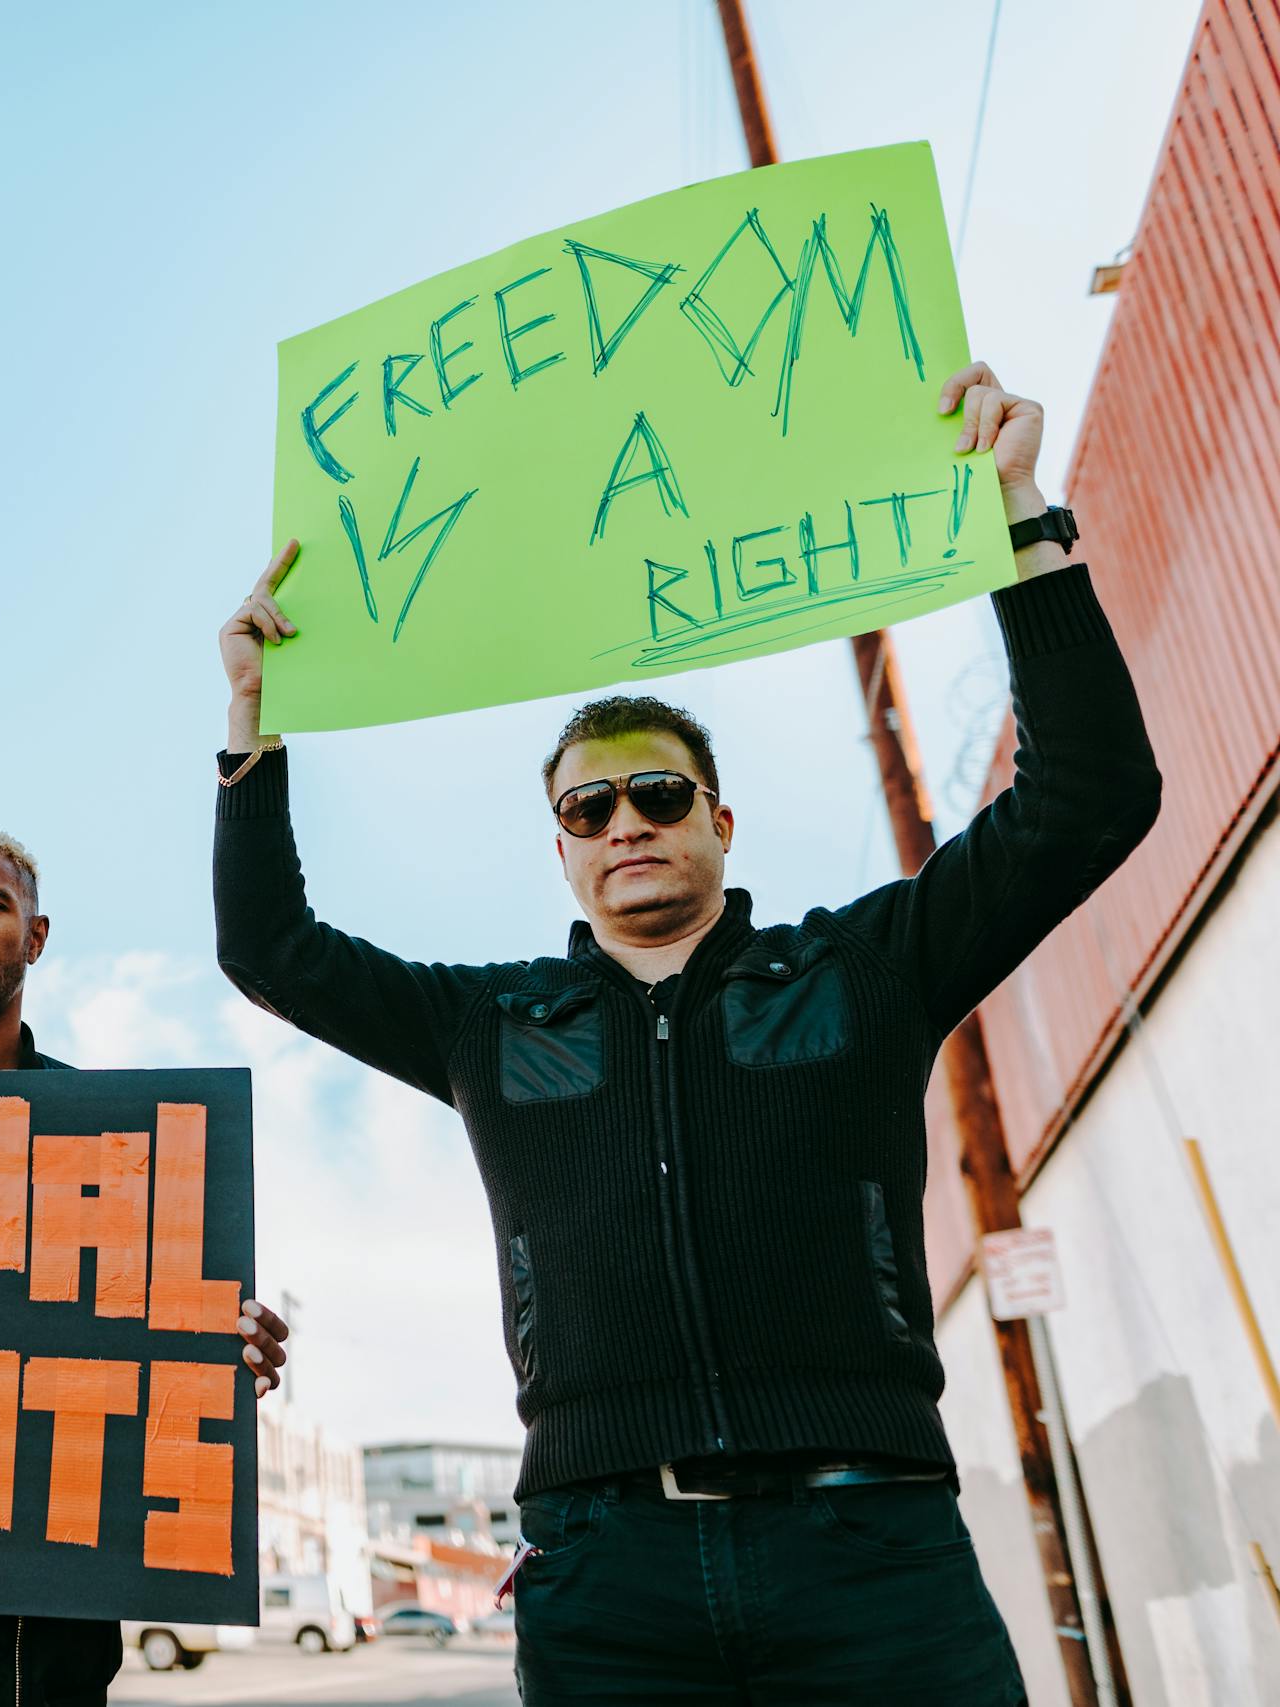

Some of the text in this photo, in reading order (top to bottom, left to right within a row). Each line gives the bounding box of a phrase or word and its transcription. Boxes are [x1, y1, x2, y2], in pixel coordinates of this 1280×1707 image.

[301, 203, 924, 483] FREEDOM
[339, 411, 690, 642] IS A
[644, 464, 973, 640] RIGHT!
